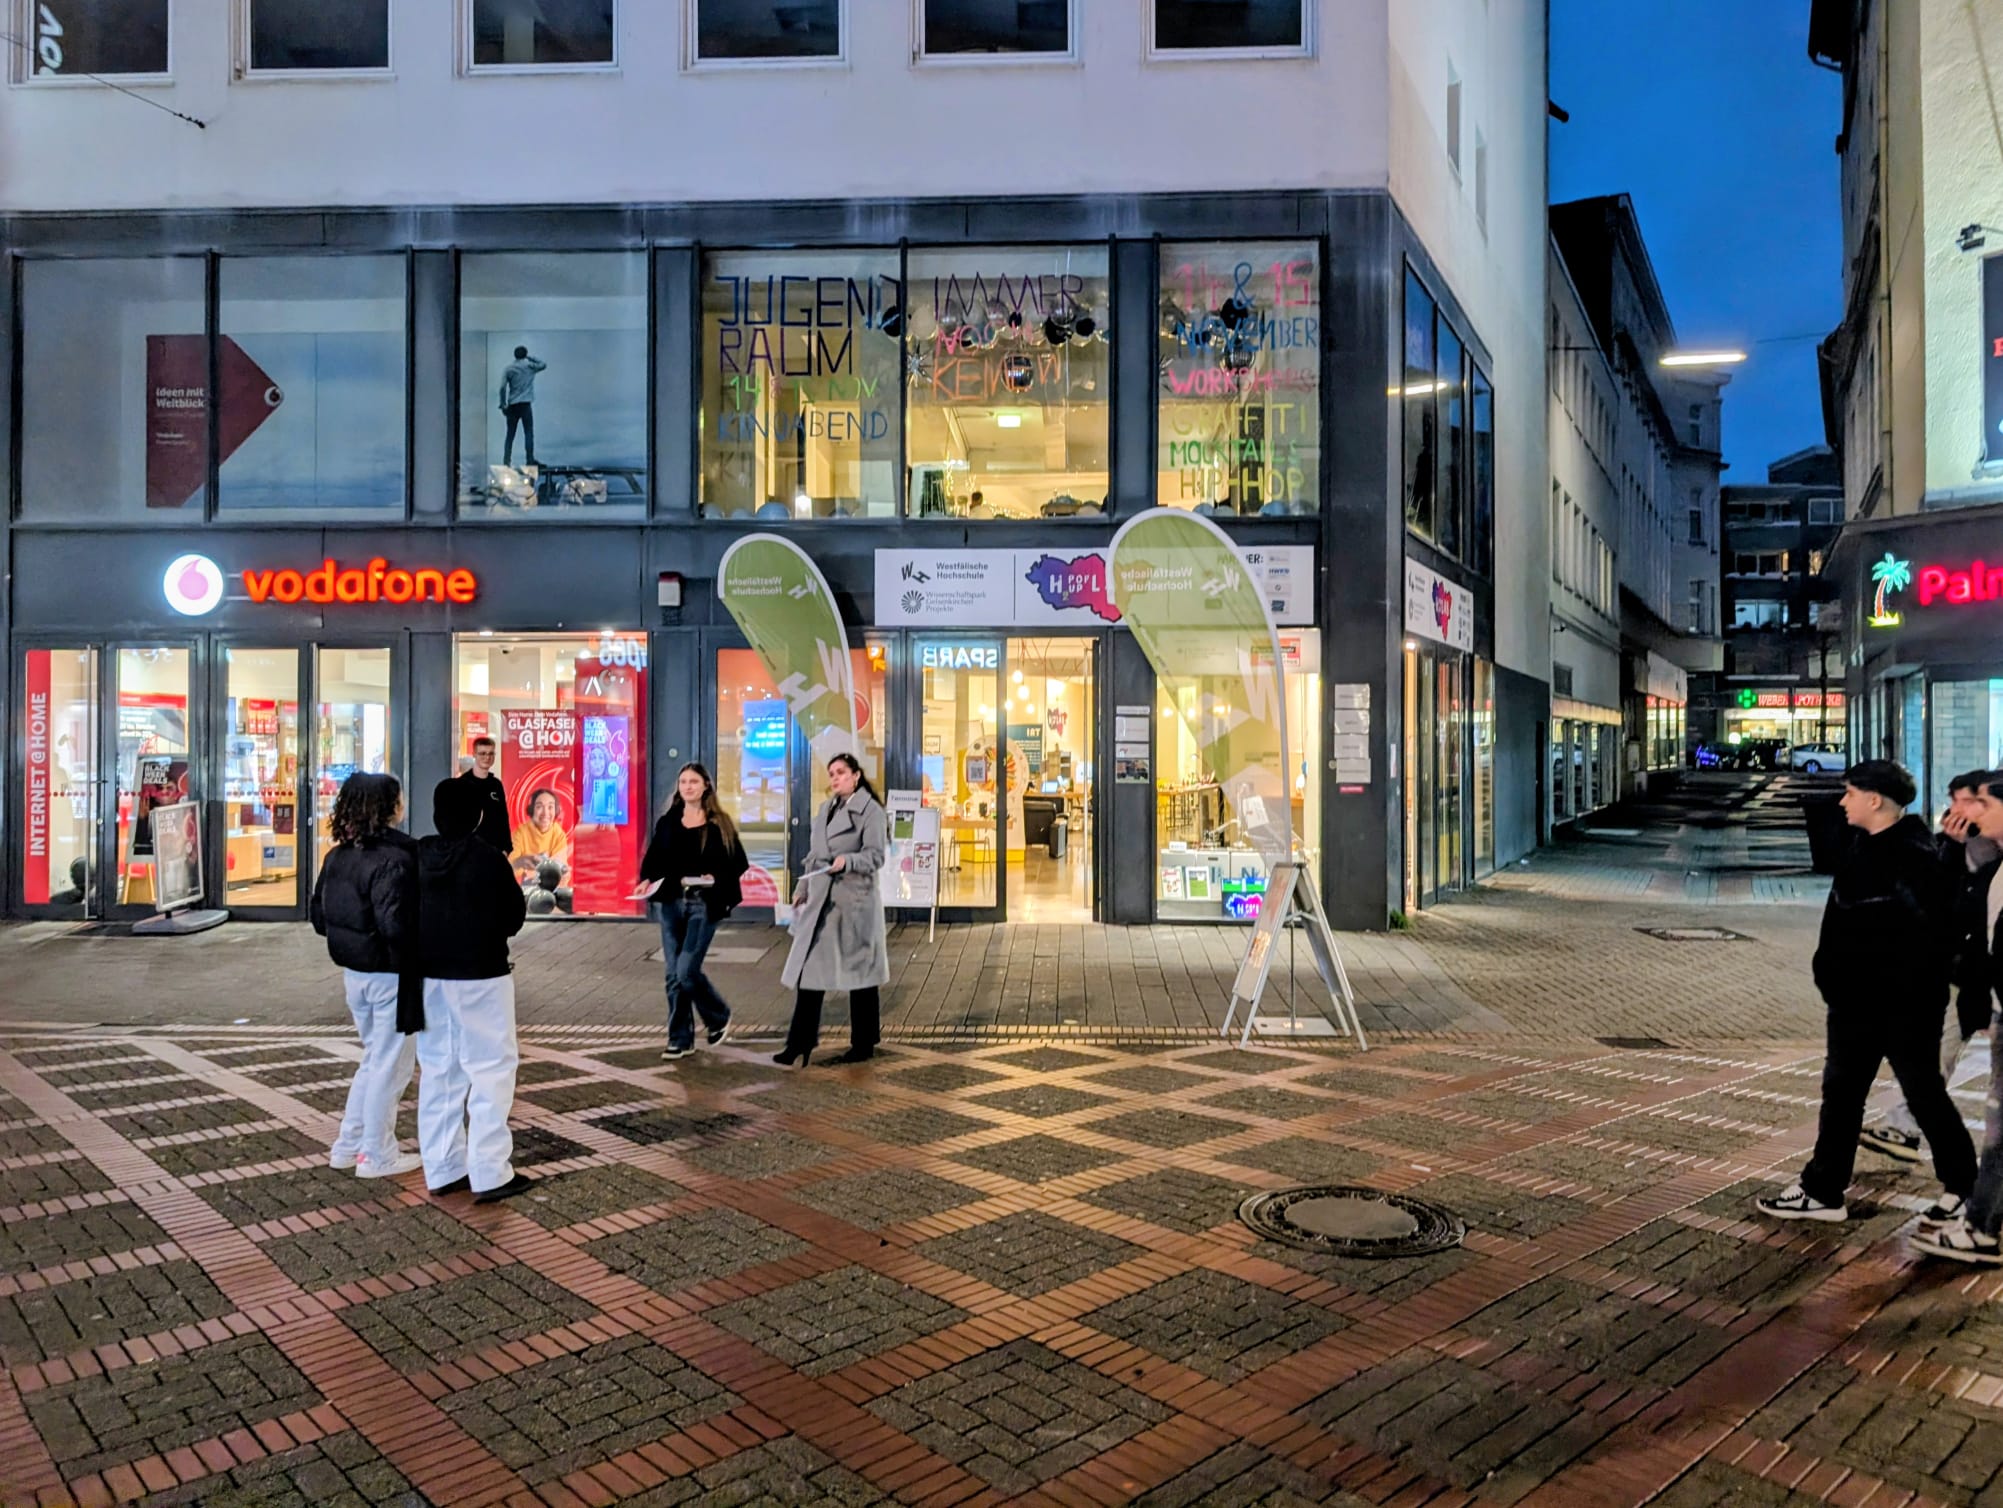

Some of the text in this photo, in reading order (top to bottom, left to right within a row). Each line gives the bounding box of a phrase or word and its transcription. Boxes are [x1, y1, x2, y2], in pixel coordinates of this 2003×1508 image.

[715, 274, 903, 330] JUGEND
[934, 271, 1084, 322] IMMER
[1233, 262, 1256, 310] &
[1263, 260, 1314, 307] 15
[719, 326, 854, 377] RAUM
[1175, 315, 1319, 357] NOVEMBER
[156, 398, 206, 409] Weltblick
[1180, 467, 1307, 503] HIP-HOP
[242, 557, 477, 603] vodafone
[936, 562, 990, 571] Westfälische
[936, 572, 985, 581] Hochschule
[30, 766, 46, 857] INTERNET
